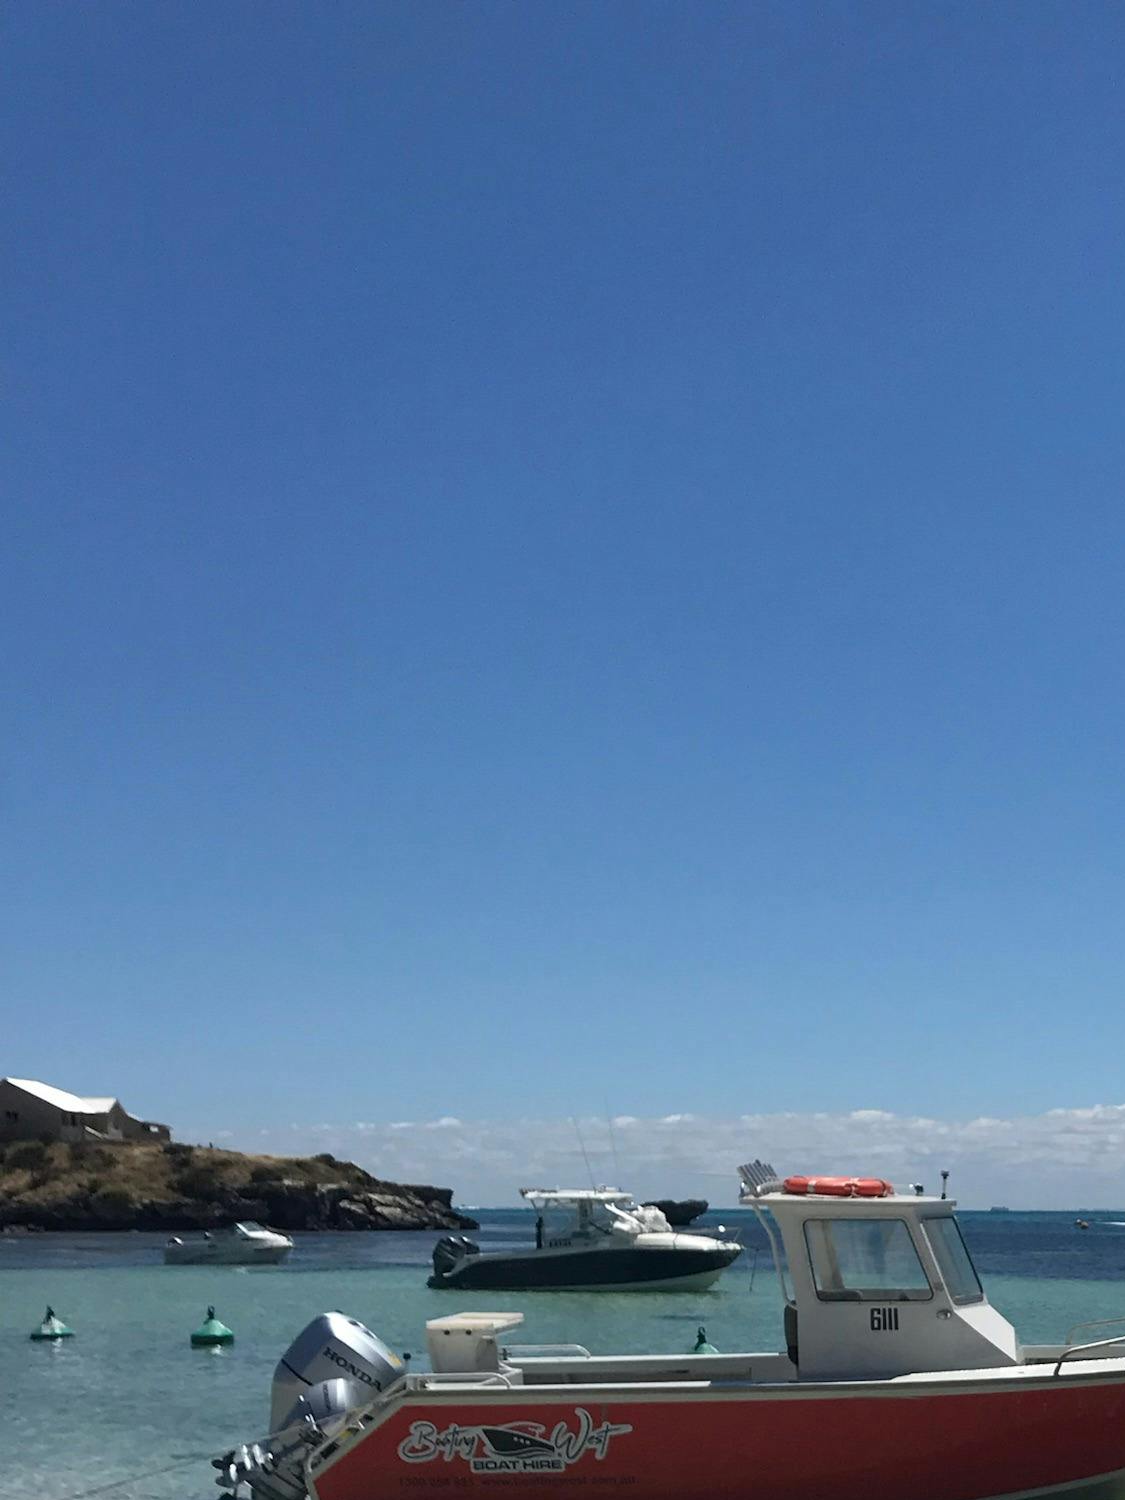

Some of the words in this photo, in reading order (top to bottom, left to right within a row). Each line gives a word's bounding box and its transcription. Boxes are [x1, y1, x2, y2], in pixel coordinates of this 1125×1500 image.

[323, 1346, 382, 1392] HONDA
[400, 1422, 477, 1461] Boating
[552, 1408, 633, 1461] West
[473, 1459, 519, 1471] BOAT
[522, 1459, 563, 1470] HIRE
